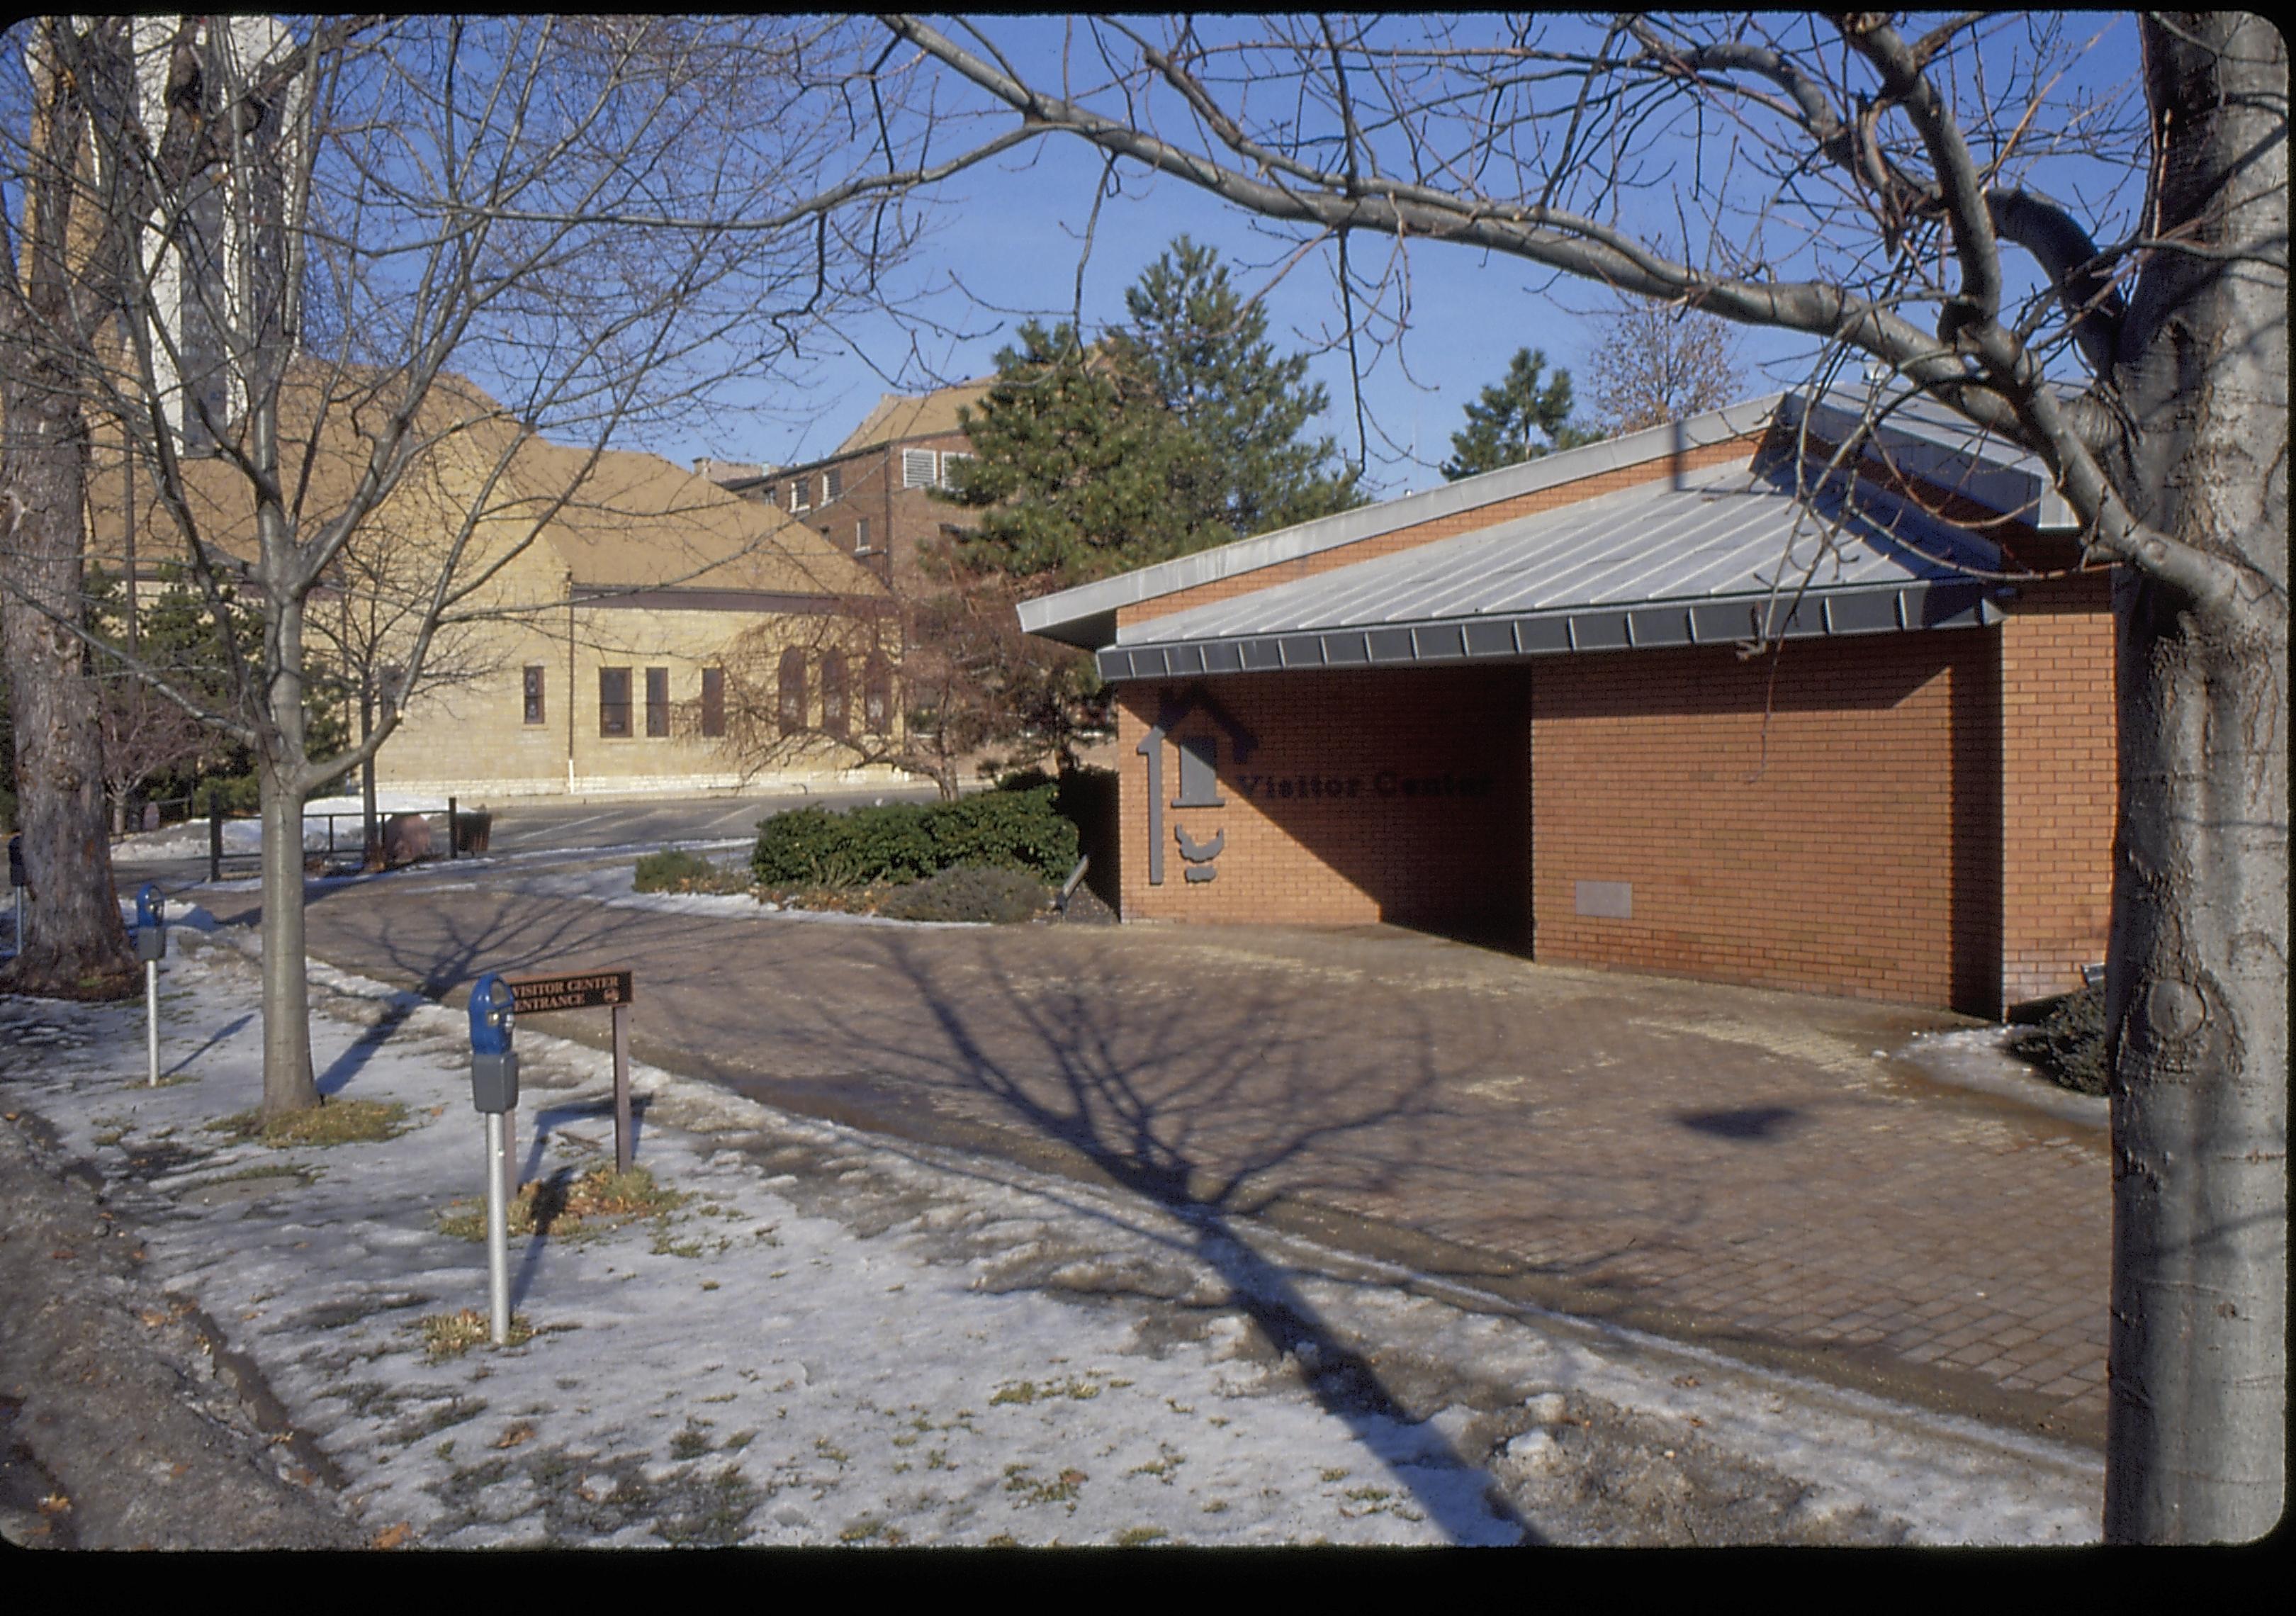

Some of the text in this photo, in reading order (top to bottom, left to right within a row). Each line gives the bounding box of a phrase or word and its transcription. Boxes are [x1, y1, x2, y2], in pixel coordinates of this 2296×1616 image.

[1237, 770, 1494, 798] Visitor Center
[512, 975, 618, 997] VISITOR CENTER
[514, 993, 585, 1011] ENTRANCE
